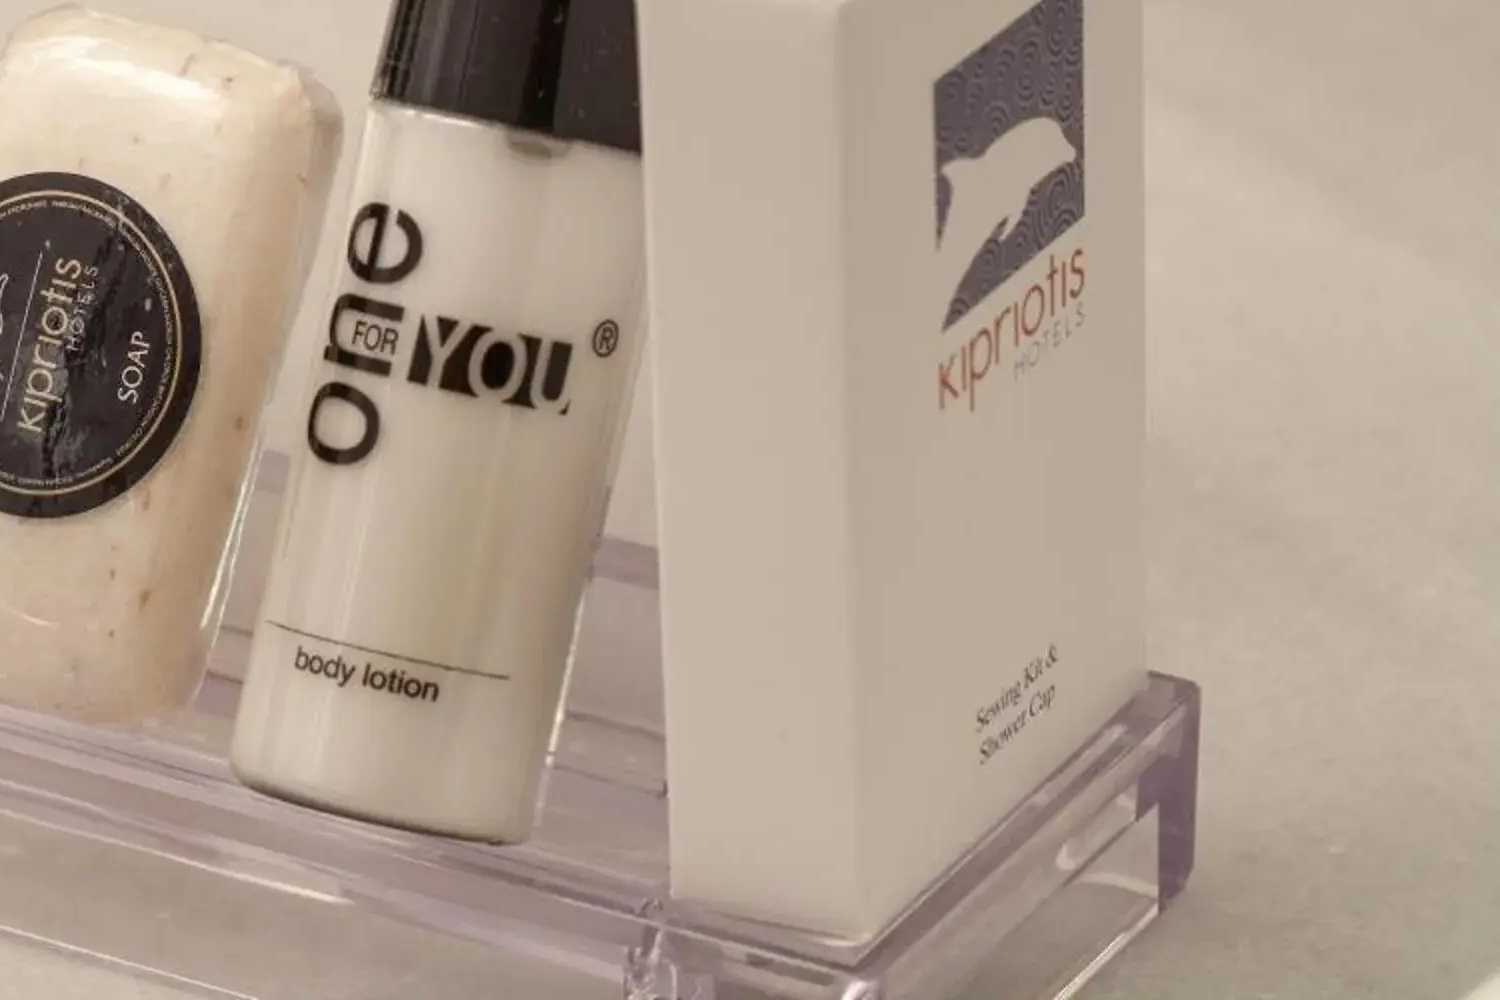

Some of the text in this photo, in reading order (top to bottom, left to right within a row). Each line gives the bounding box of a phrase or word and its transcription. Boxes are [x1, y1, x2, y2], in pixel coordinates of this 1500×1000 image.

[66, 264, 100, 351] HOTELS
[351, 320, 400, 356] FOR
[1014, 301, 1087, 381] HOTELS
[117, 330, 152, 404] SOAP
[294, 645, 440, 702] body lotion
[975, 680, 1022, 734] Sewing
[1023, 657, 1044, 689] Kit
[978, 684, 1056, 766] Shower Cap
